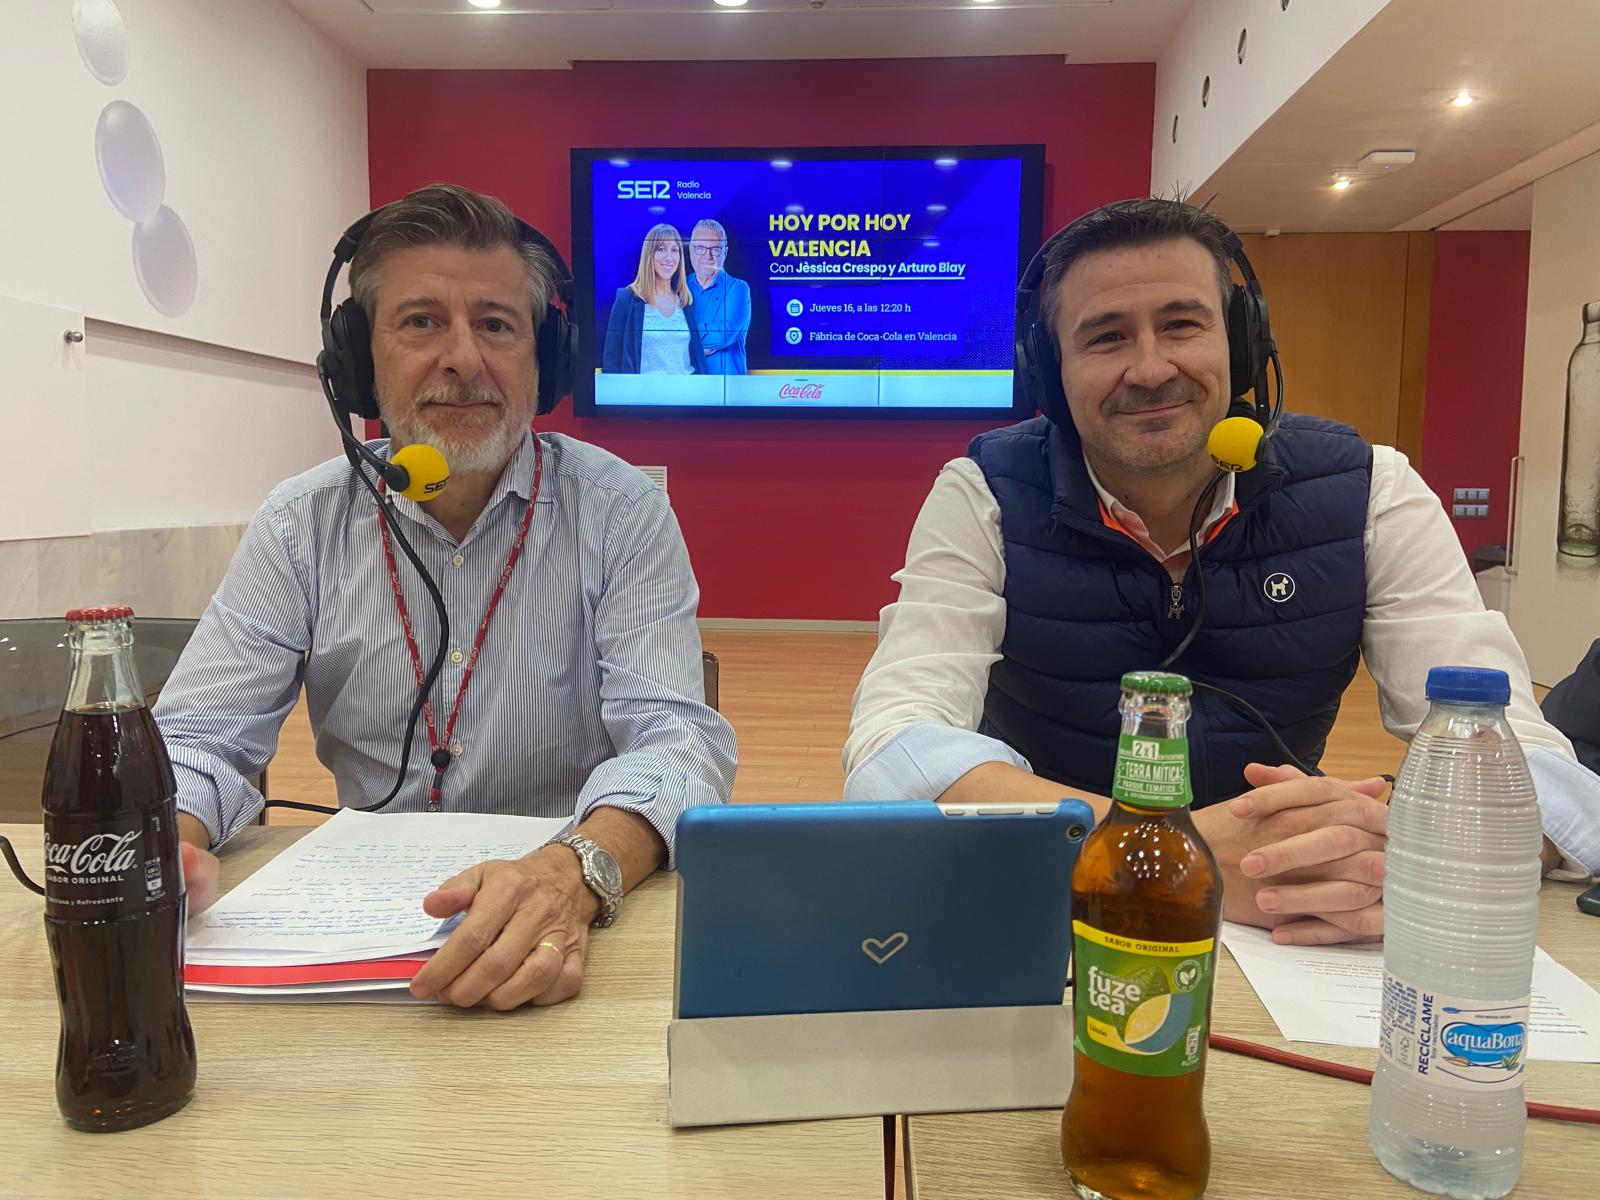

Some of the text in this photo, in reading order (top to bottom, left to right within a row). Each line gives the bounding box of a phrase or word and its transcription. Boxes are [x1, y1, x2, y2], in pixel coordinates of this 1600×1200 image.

[617, 180, 670, 199] SER
[677, 181, 700, 189] Radio
[677, 191, 712, 200] Valencia
[769, 213, 911, 231] HOY POR HOY
[768, 240, 871, 257] VALENCIA
[769, 261, 966, 276] Con Jèssica Crespo y Arturo Blay
[809, 303, 842, 312] Jueves
[843, 303, 856, 314] 16,
[864, 303, 878, 312] las
[880, 303, 903, 313] 12:20
[904, 303, 912, 312] h
[809, 332, 844, 341] Fábrica
[844, 332, 856, 341] de
[856, 332, 903, 341] Coca-Cola
[917, 332, 958, 341] Valencia
[778, 383, 825, 399] Coca-Cola
[1134, 742, 1157, 759] 2x1
[1125, 762, 1181, 782] TERRA MÍTICA
[71, 875, 124, 885] ORIGINAL
[1104, 936, 1180, 954] SABOR ORIGINAL
[1087, 965, 1141, 1002] fuze
[1088, 987, 1126, 1016] tea
[1417, 993, 1434, 1075] RECÍCLAME
